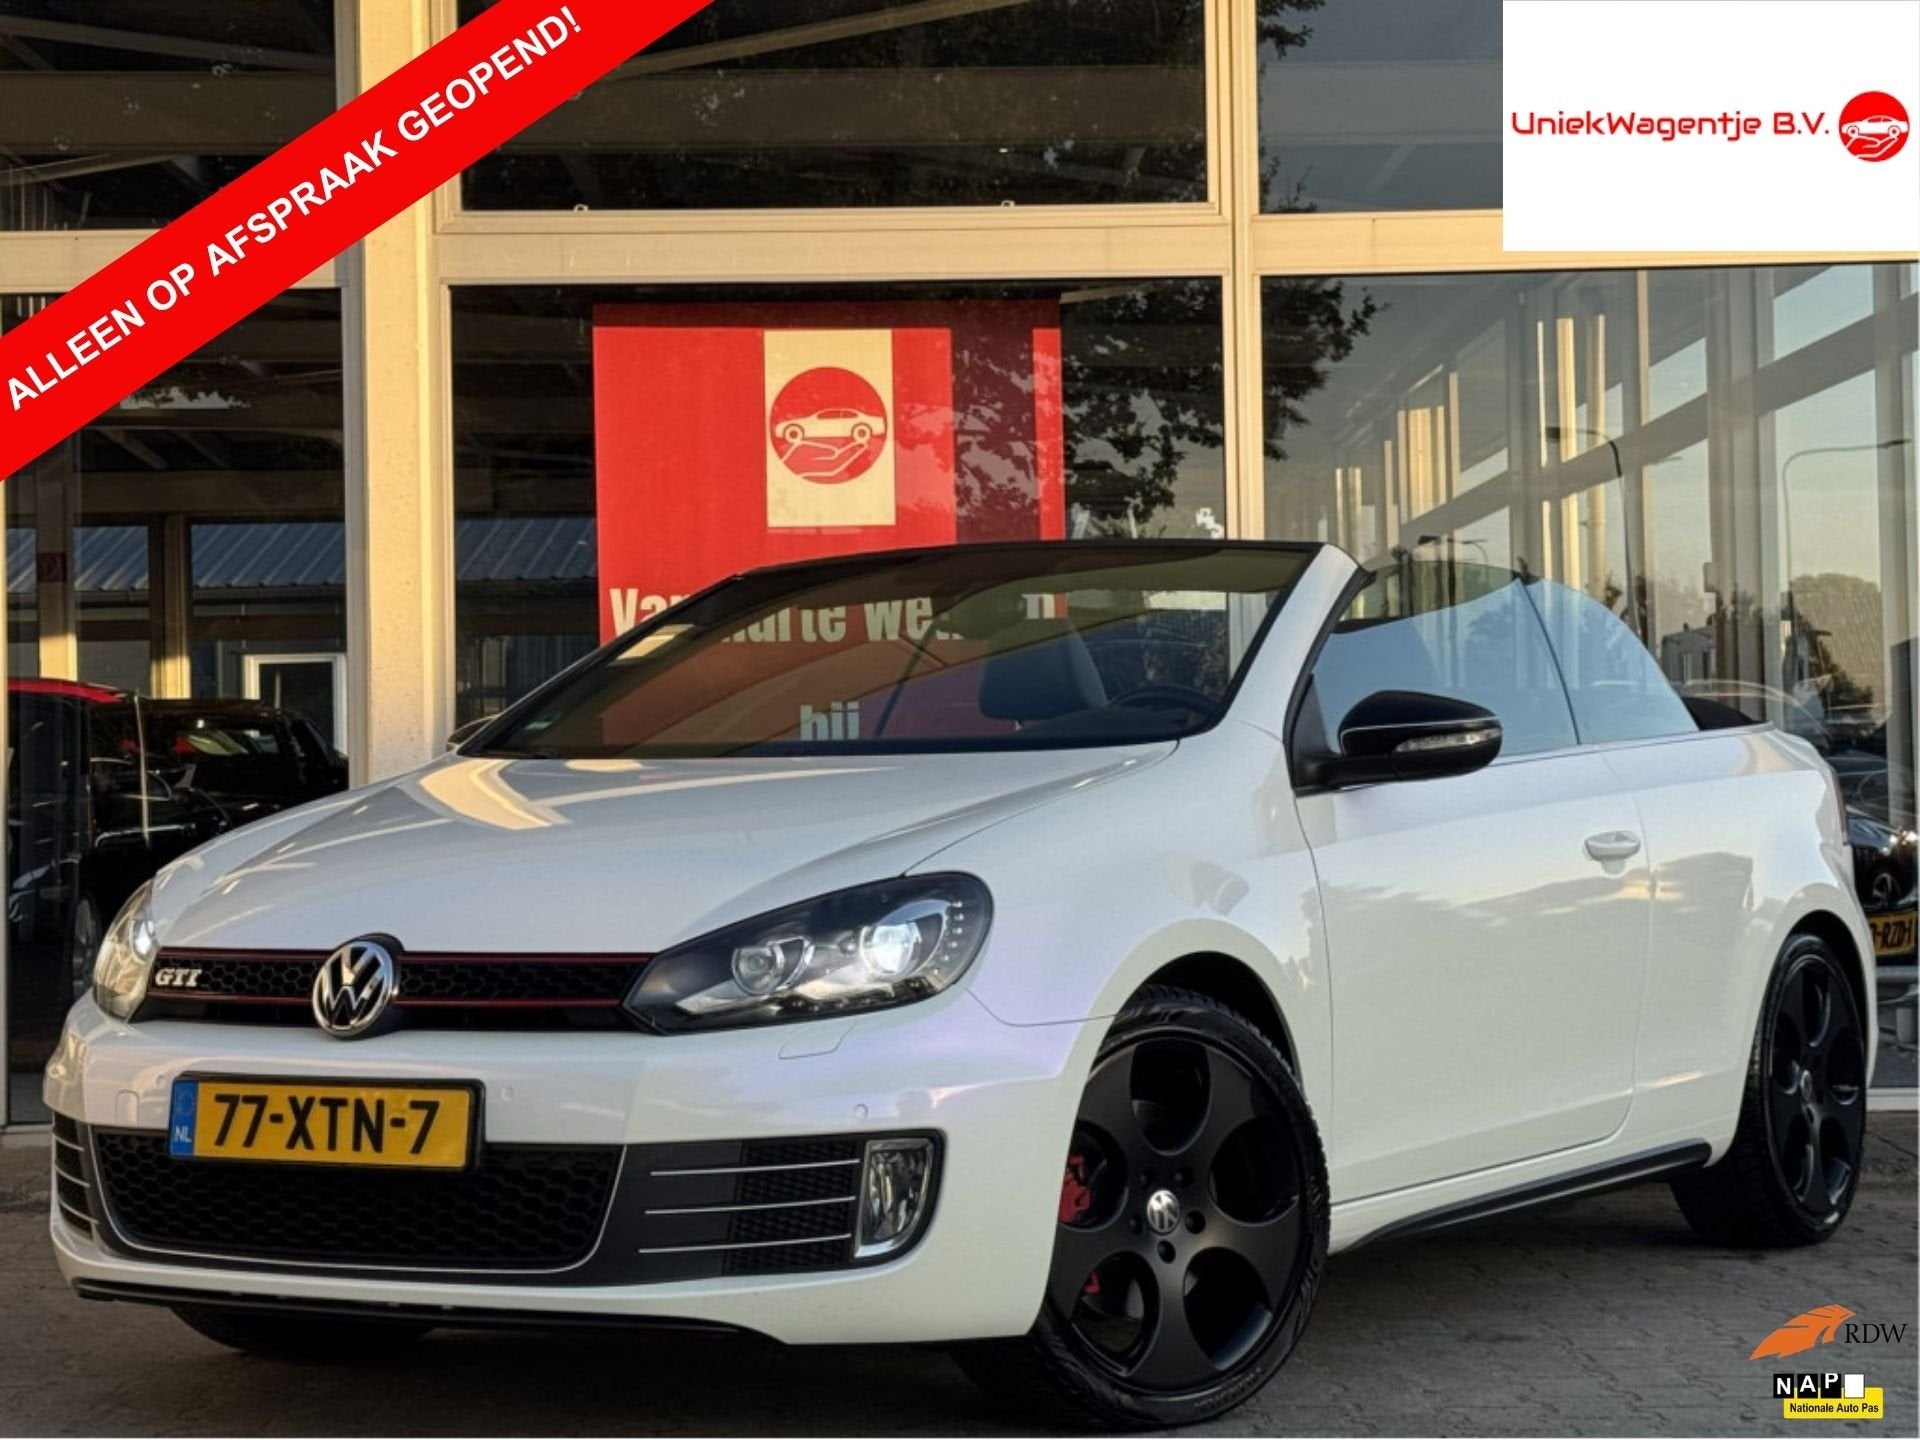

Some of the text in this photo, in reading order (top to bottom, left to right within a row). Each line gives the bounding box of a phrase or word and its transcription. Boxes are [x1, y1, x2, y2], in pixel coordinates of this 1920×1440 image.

[155, 968, 202, 988] GTI
[174, 1125, 193, 1143] NL
[213, 1093, 440, 1155] 77-XTN-7
